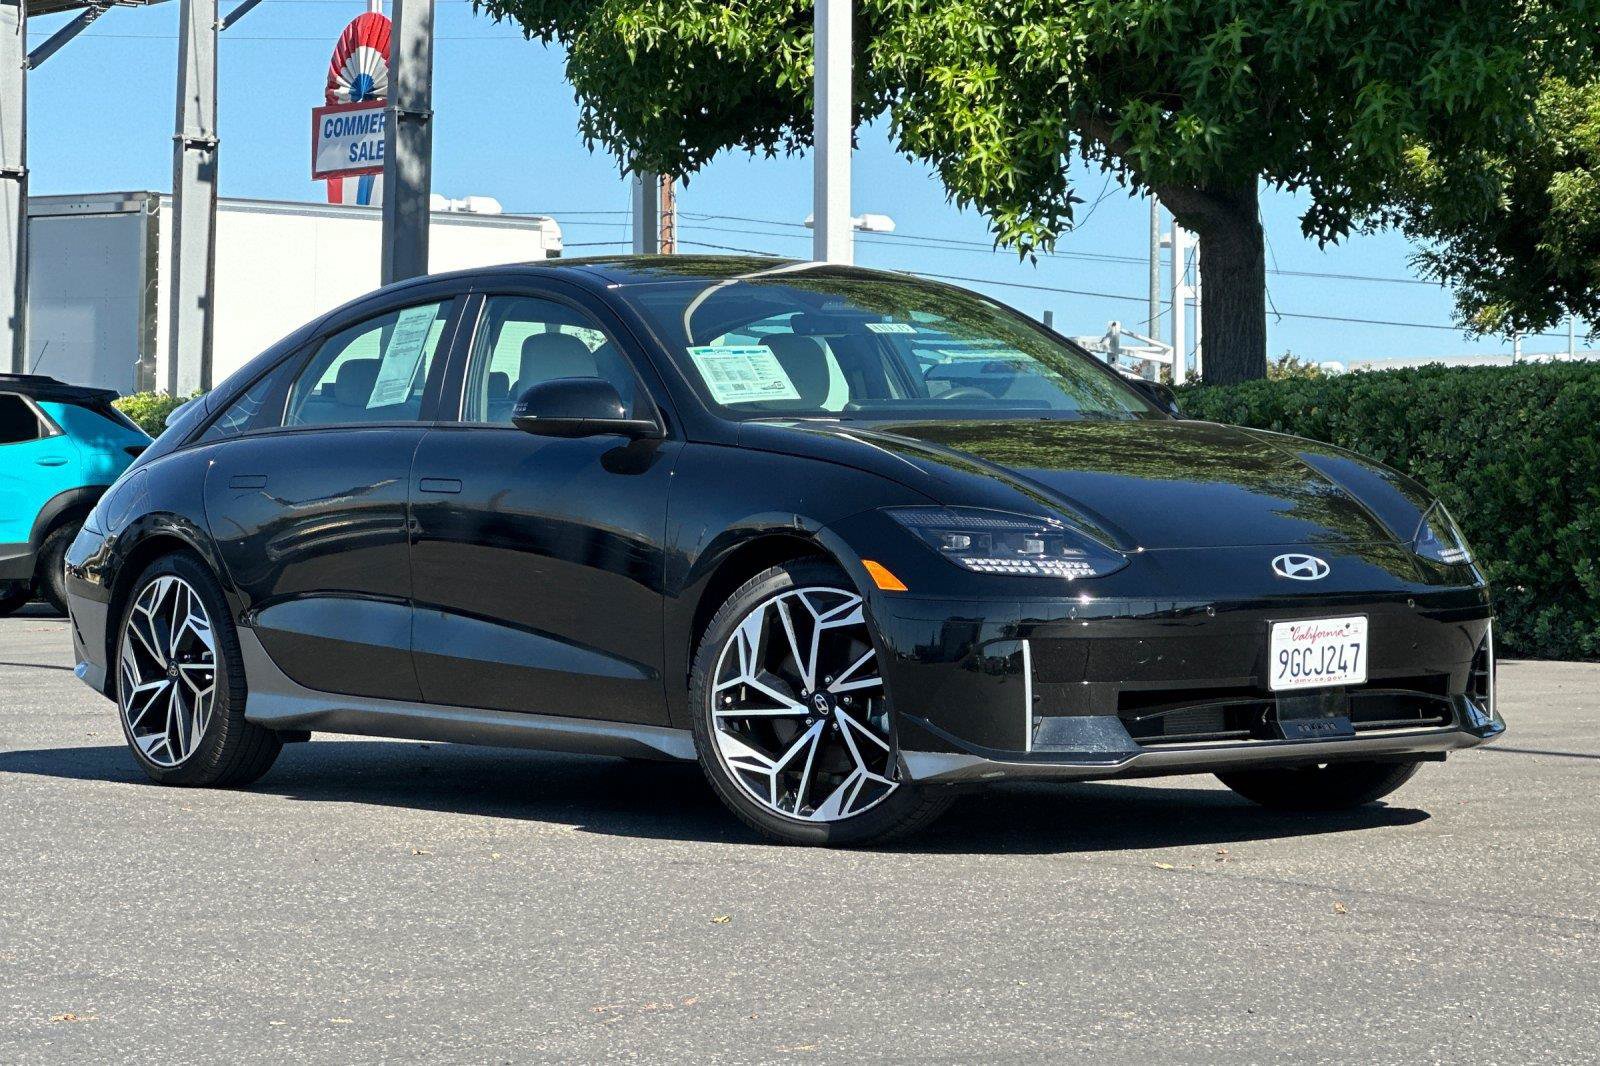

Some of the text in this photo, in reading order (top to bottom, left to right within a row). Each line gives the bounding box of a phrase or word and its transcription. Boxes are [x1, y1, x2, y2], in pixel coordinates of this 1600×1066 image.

[349, 140, 385, 162] SALE
[1291, 625, 1349, 644] California
[1279, 643, 1360, 679] 9GCJ247
